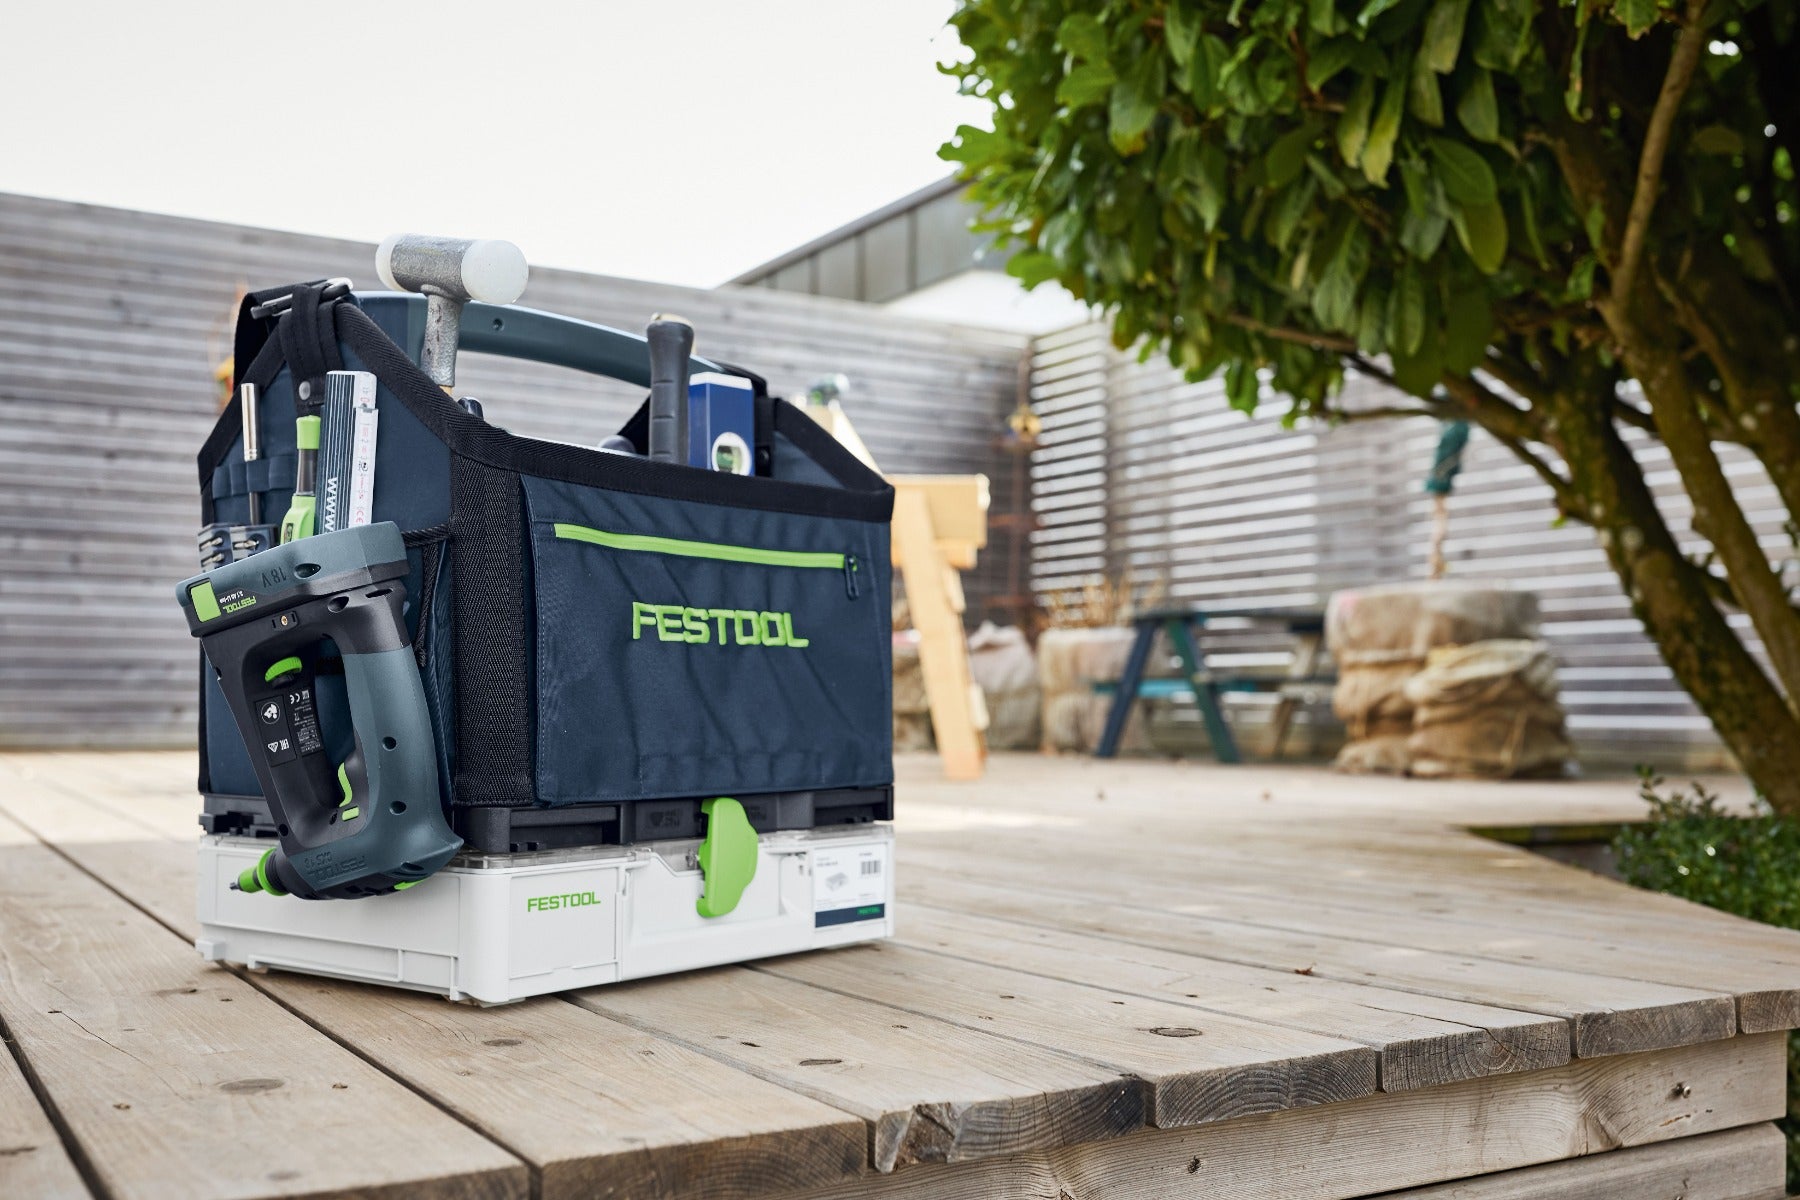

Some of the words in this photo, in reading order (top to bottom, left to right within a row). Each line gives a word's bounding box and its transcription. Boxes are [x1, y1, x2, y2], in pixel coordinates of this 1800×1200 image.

[261, 572, 272, 588] V
[271, 567, 287, 584] 18
[222, 595, 257, 613] FESTOOL
[632, 602, 809, 648] FESTOOL
[527, 891, 601, 912] FESTOOL
